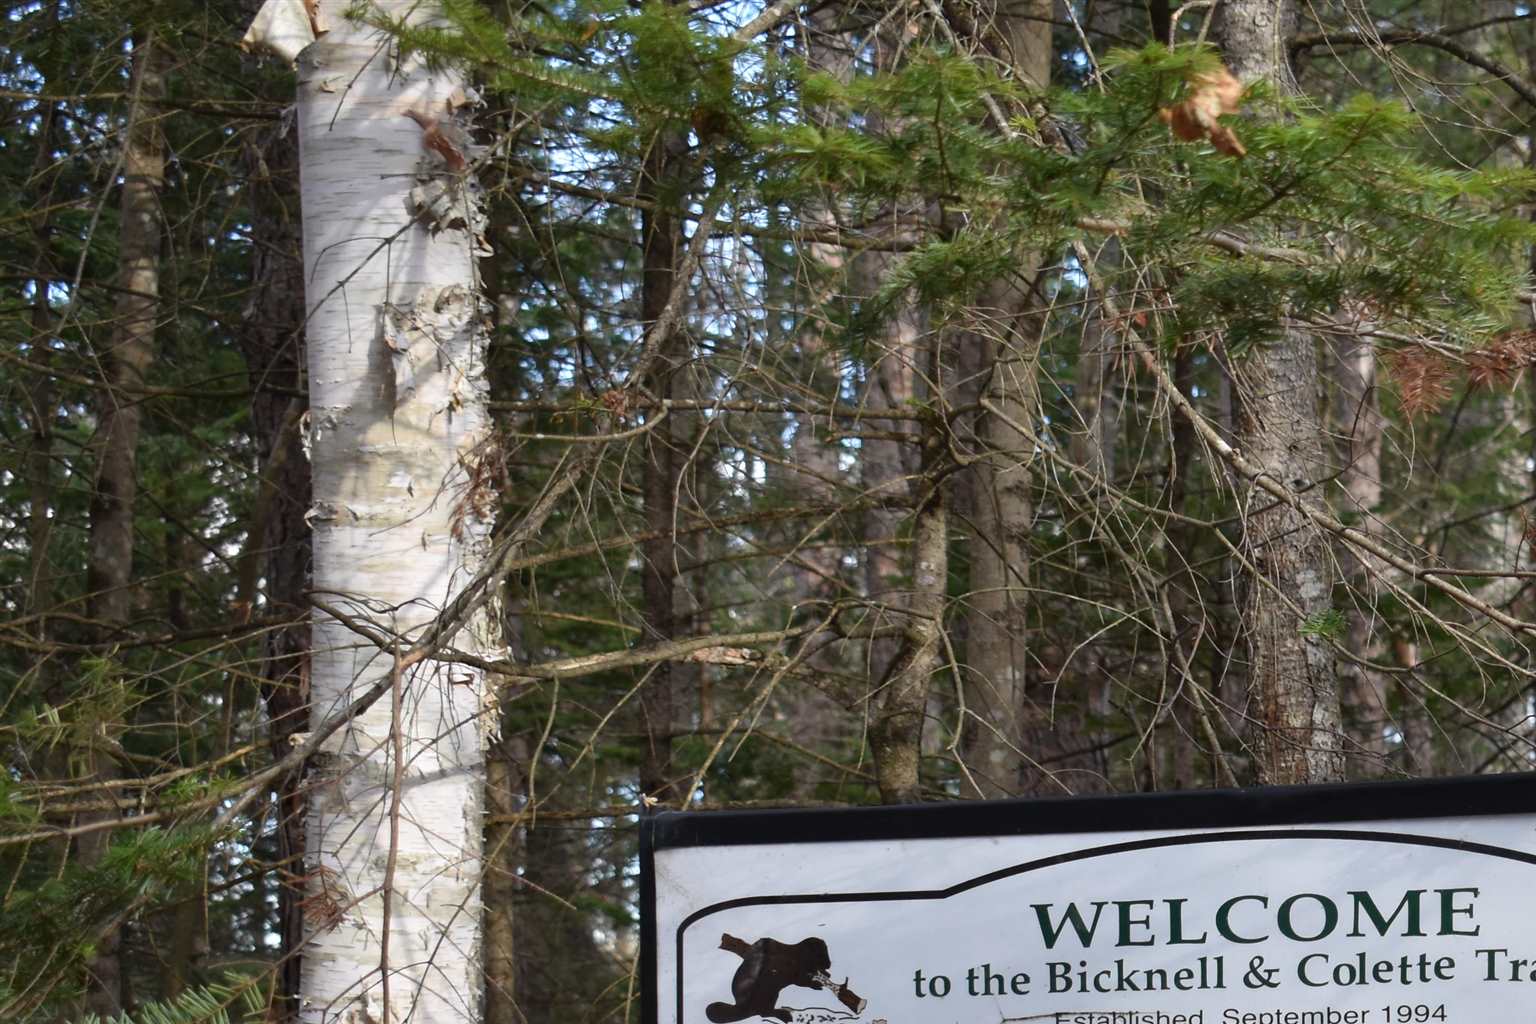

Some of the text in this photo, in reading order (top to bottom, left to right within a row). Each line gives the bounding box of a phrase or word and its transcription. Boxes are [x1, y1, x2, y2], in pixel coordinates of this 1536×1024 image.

[1030, 888, 1480, 949] WELCOME
[913, 969, 951, 998] to
[966, 964, 1030, 996] the
[1046, 956, 1226, 993] Bicknell
[1243, 956, 1280, 989] &
[1298, 952, 1455, 987] Colette
[1382, 1004, 1447, 1023] 1994
